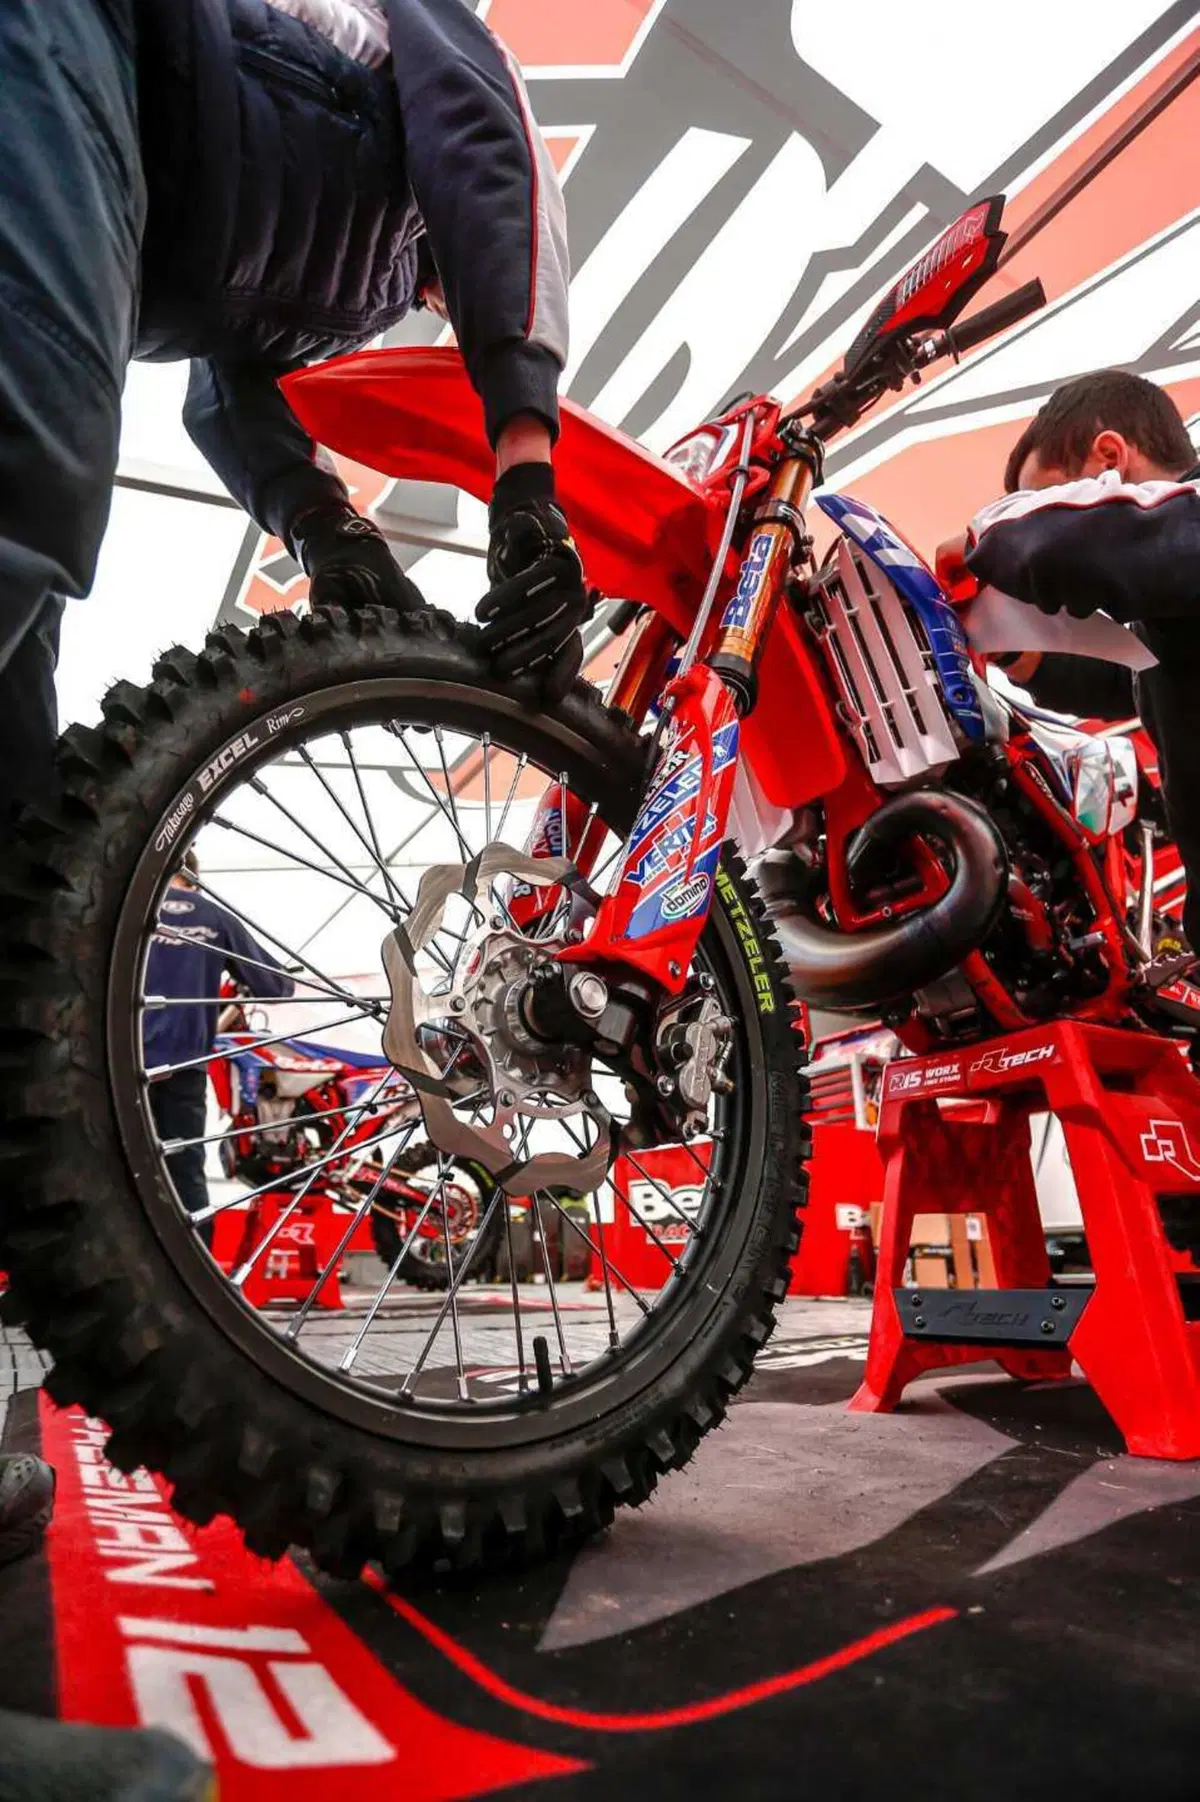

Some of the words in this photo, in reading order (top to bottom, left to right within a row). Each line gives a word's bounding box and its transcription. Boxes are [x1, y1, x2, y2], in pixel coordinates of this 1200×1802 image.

[719, 533, 776, 627] Beta
[195, 731, 259, 792] EXCEL
[662, 878, 708, 912] domino
[716, 863, 776, 1014] METZELER
[926, 1064, 961, 1078] WORX
